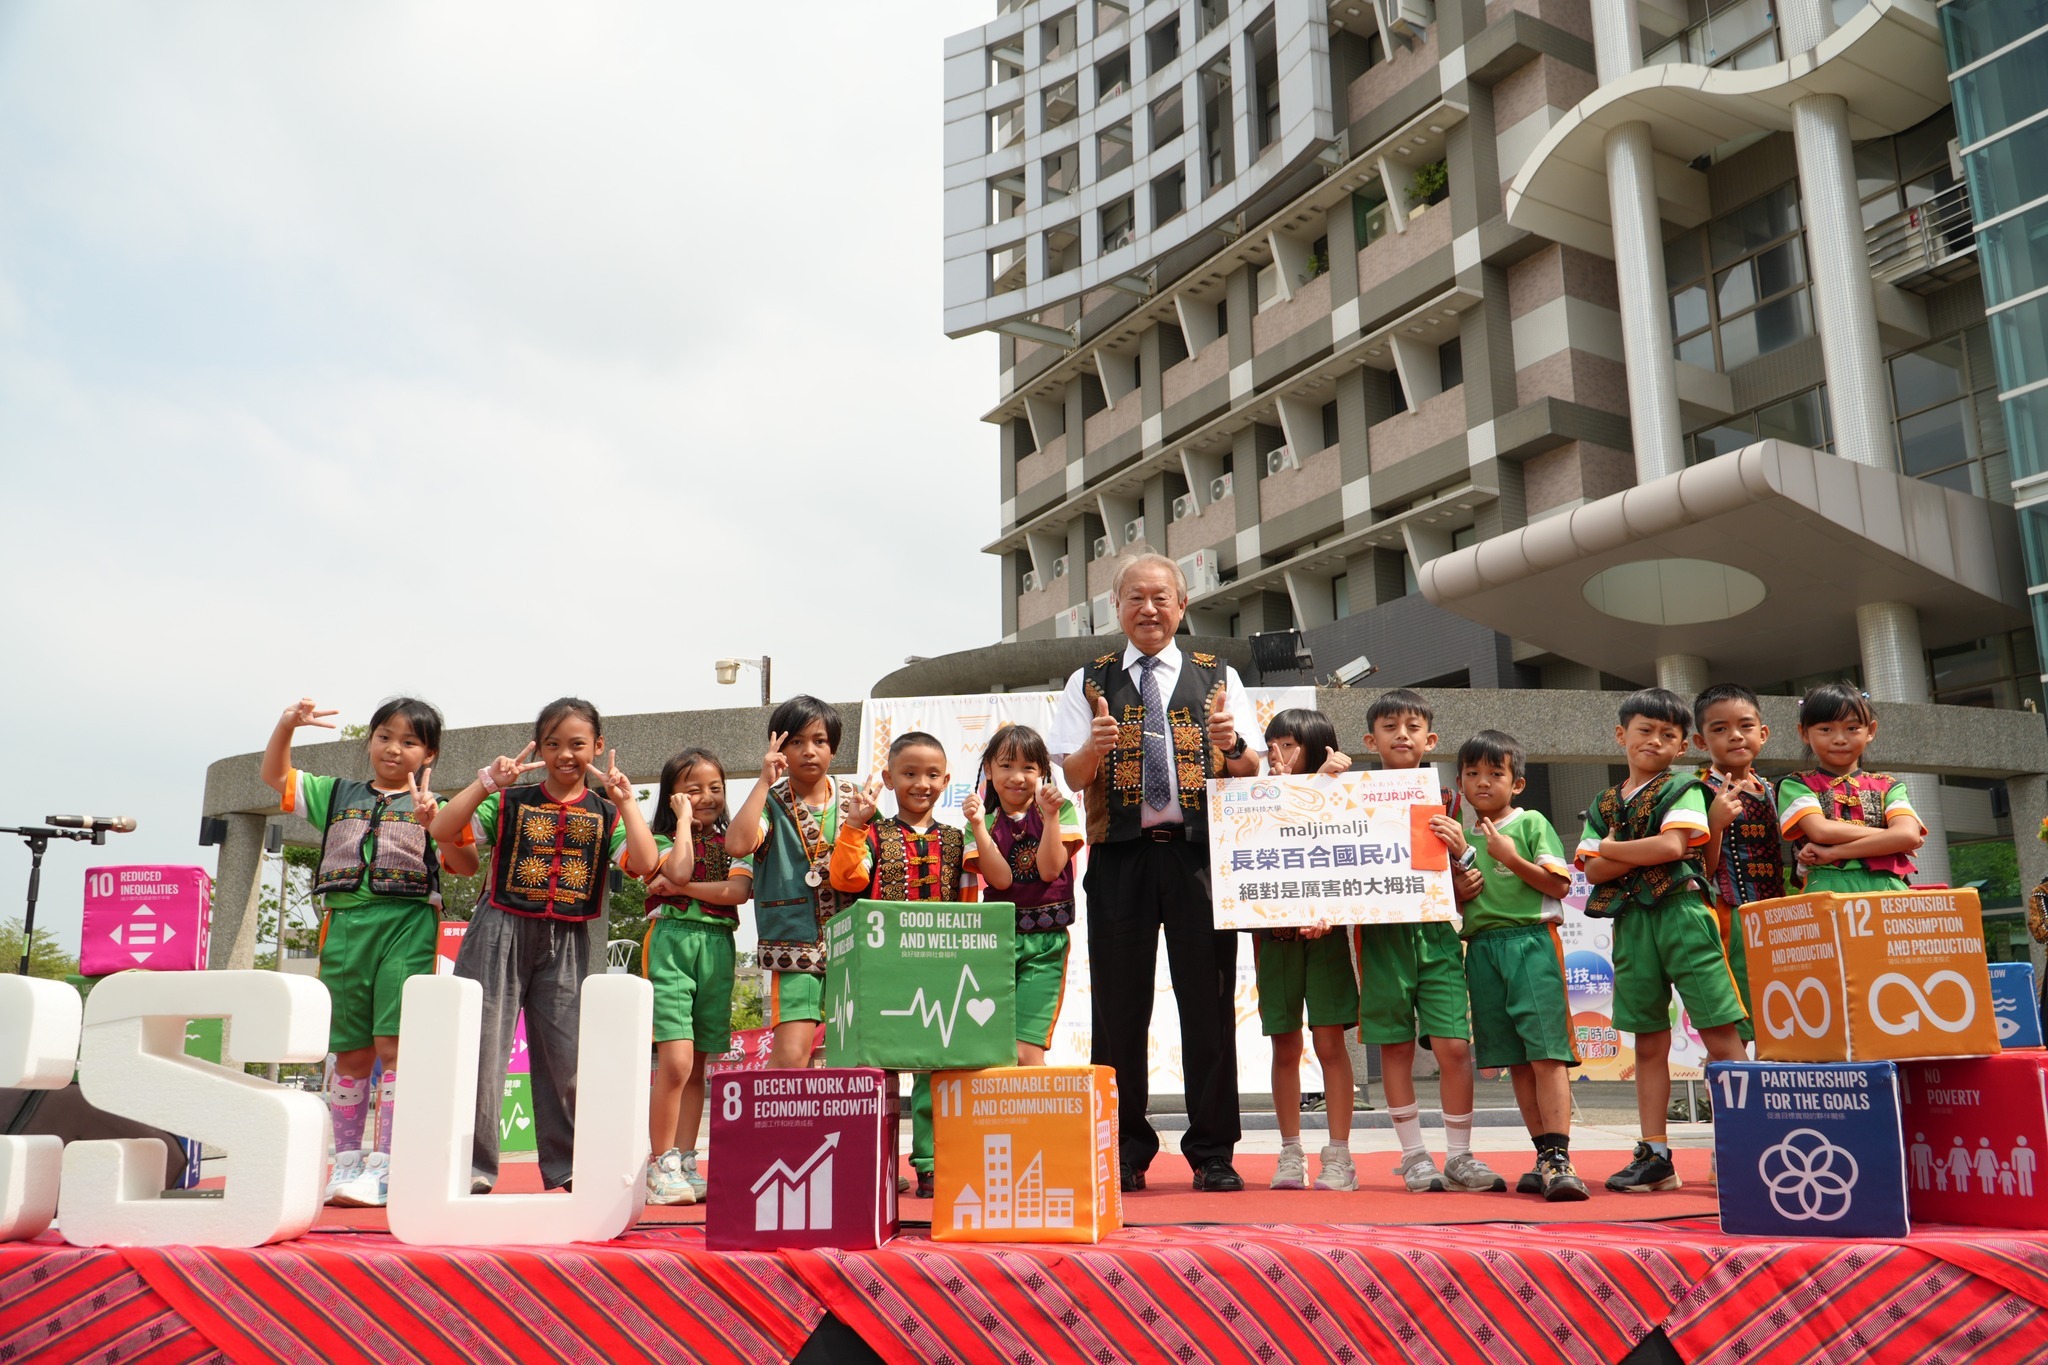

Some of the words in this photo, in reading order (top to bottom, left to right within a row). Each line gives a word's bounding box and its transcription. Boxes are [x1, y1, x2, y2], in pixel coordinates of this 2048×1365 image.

[1237, 805, 1282, 814] 正修科技大學
[1280, 820, 1369, 840] maljimalji
[1231, 842, 1410, 872] 長榮百合國民小
[89, 872, 114, 898] 10
[120, 871, 162, 882] REDUCED
[120, 884, 179, 895] INEQUALITIES
[1239, 876, 1426, 901] 絕對是厲害的大拇指
[1744, 912, 1764, 949] 12
[1764, 902, 1814, 925] RESPONSIBLE
[1843, 899, 1874, 937] 12
[1880, 896, 1956, 914] RESPONSIBLE
[1883, 916, 1964, 935] CONSUMPTION
[867, 911, 885, 948] 3
[900, 912, 934, 928] GOOD
[937, 913, 982, 928] HEALTH
[1768, 923, 1820, 946] CONSUMPTION
[900, 933, 925, 949] AND
[928, 933, 998, 949] WELL-BEING
[1887, 940, 1910, 956] AND
[1912, 937, 1982, 955] PRODUCTION
[1771, 948, 1786, 965] AND
[1786, 942, 1834, 962] PRODUCTION
[1924, 1068, 1940, 1084] NO
[722, 1081, 743, 1121] 8
[754, 1078, 803, 1096] DECENT
[805, 1077, 843, 1095] WORK
[847, 1076, 874, 1093] AND
[937, 1079, 962, 1117] 11
[971, 1077, 1051, 1095] SUSTAINABLE
[1053, 1075, 1090, 1093] CITIES
[1717, 1070, 1749, 1109] 17
[1761, 1070, 1868, 1088] PARTNERSHIPS
[1927, 1089, 1980, 1106] POVERTY
[754, 1100, 820, 1119] ECONOMIC
[822, 1098, 877, 1117] GROWTH
[972, 1099, 997, 1116] AND
[1000, 1097, 1083, 1116] COMMUNITIES
[1764, 1093, 1791, 1111] FOR
[1793, 1093, 1820, 1110] THE
[1823, 1092, 1871, 1110] GOALS
